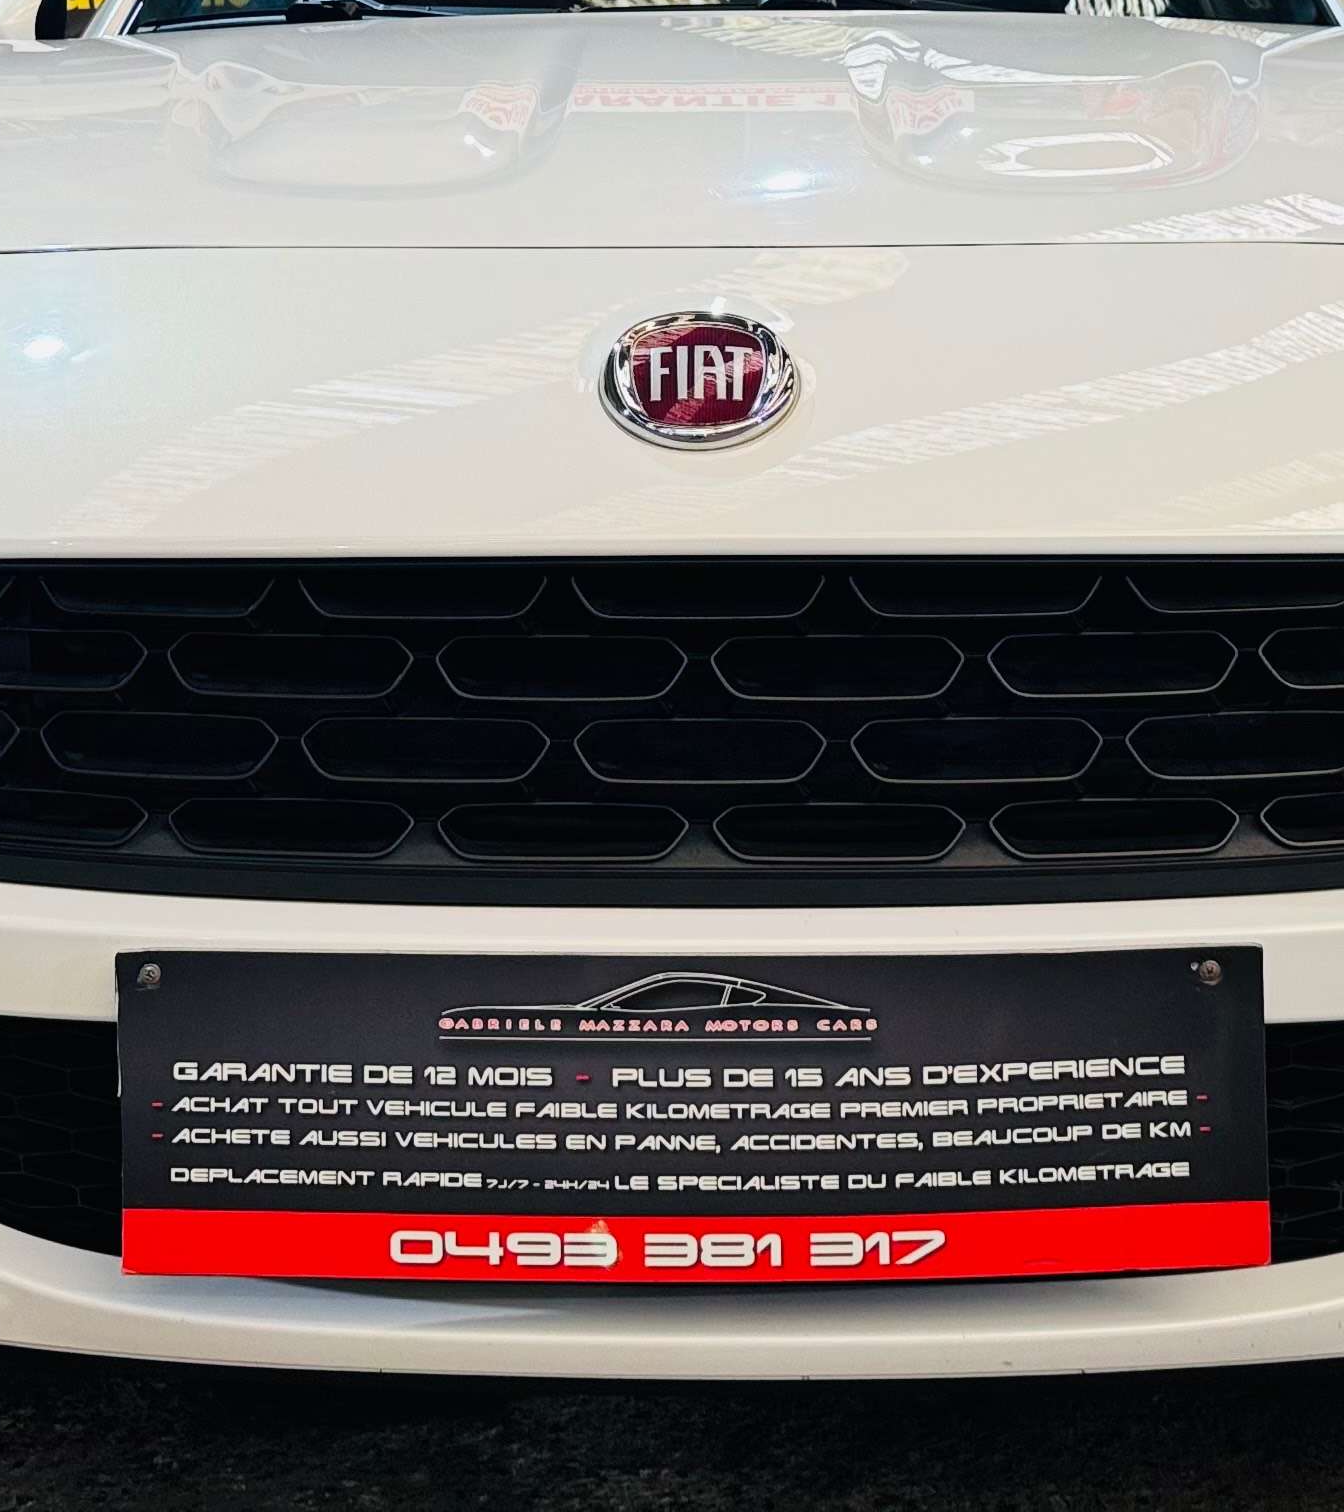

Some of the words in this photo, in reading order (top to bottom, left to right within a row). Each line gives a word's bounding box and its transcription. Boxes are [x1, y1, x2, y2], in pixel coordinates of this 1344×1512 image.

[649, 345, 753, 402] FIAT
[438, 1017, 562, 1031] GABRIELE
[578, 1019, 690, 1032] MAZZARA
[704, 1019, 799, 1033] MOTORS
[816, 1018, 878, 1031] CARS
[173, 1061, 353, 1084] GARANTIE
[363, 1064, 413, 1085] DE
[423, 1066, 457, 1086] 12
[467, 1066, 553, 1087] MOIS
[612, 1067, 712, 1088] PLUS
[723, 1068, 774, 1088] DE
[784, 1067, 824, 1088] 15
[834, 1066, 912, 1087] ANS
[922, 1055, 1186, 1085] D'EXPERIENCE
[171, 1096, 269, 1114] ACHAT
[277, 1098, 359, 1115] TOUT
[366, 1099, 507, 1118] VEHICULE
[515, 1102, 618, 1119] FAIBLE
[625, 1102, 831, 1120] KILOMETRAGE
[840, 1099, 969, 1119] PREMIER
[977, 1089, 1188, 1115] PROPRIETAIRE
[171, 1127, 291, 1145] ACHETE
[298, 1130, 387, 1147] AUSSI
[394, 1131, 557, 1150] VEHICULES
[565, 1134, 607, 1151] EN
[614, 1134, 721, 1154] PANNE,
[730, 1132, 924, 1151] ACCIDENTES,
[932, 1125, 1093, 1148] BEAUCOUP
[1101, 1122, 1142, 1140] DE
[1149, 1121, 1192, 1138] KM
[170, 1167, 376, 1186] DEPLACEMENT
[382, 1171, 483, 1188] RAPIDE
[486, 1178, 529, 1189] 7J/7
[544, 1179, 610, 1190] 24H/24
[614, 1175, 649, 1191] LE
[657, 1174, 840, 1191] SPECIALISTE
[847, 1173, 887, 1190] DU
[895, 1169, 992, 1189] FAIBLE
[999, 1161, 1190, 1185] KILOMETRAGE
[390, 1230, 618, 1267] 0493
[644, 1233, 782, 1267] 381
[809, 1230, 946, 1266] 317
